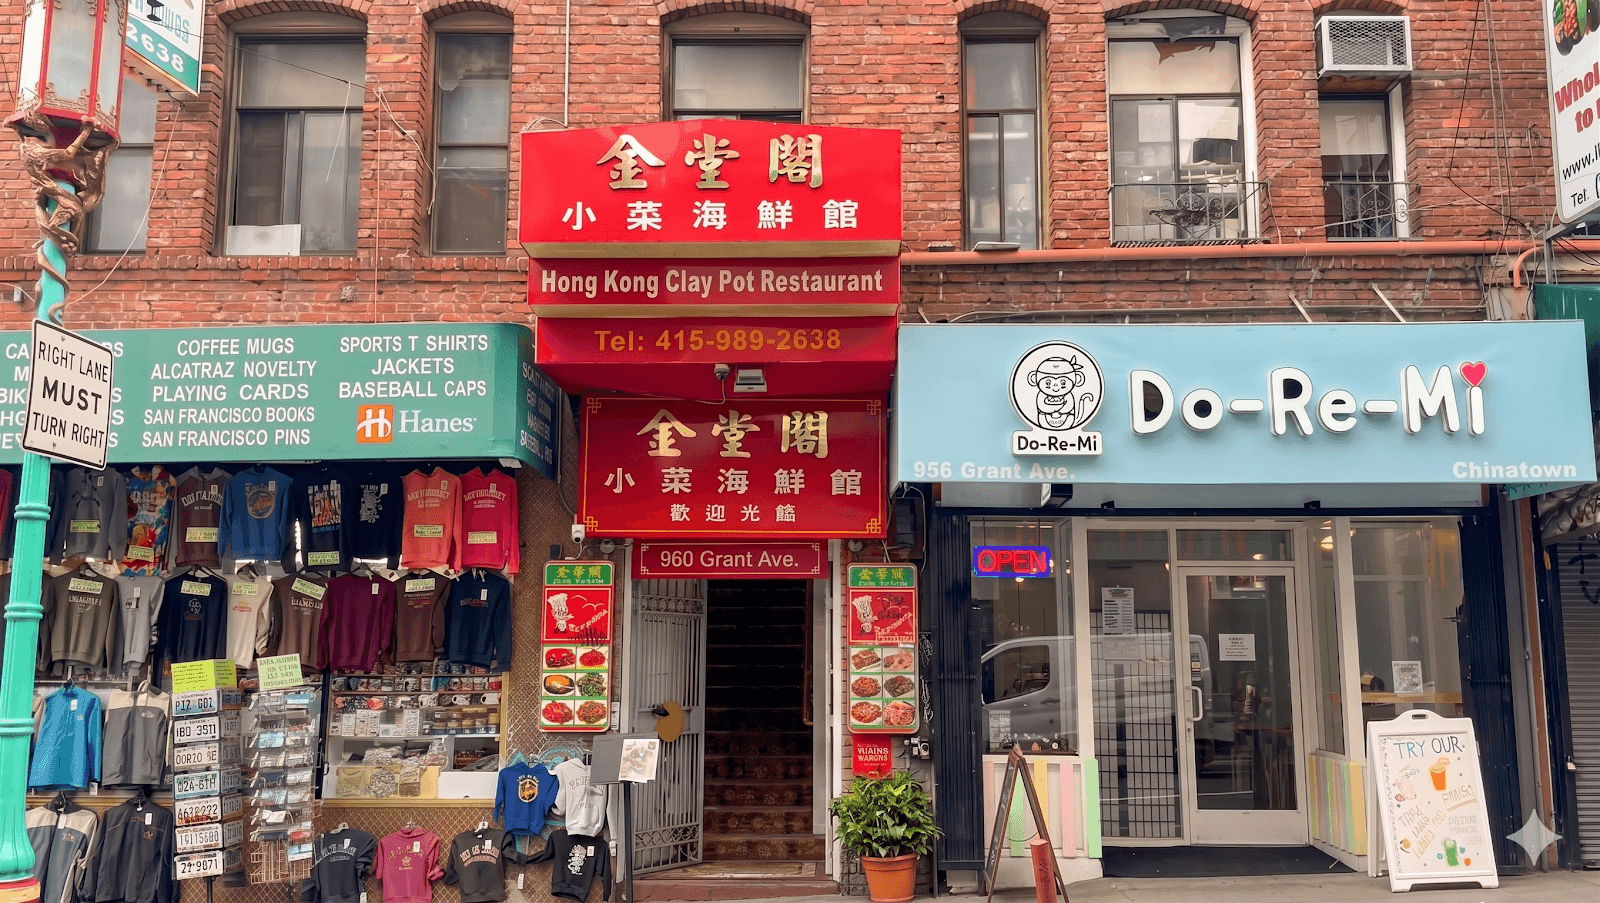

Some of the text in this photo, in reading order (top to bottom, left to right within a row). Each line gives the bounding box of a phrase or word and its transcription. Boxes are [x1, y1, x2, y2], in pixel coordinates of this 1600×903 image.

[1554, 61, 1600, 114] Whol
[1574, 107, 1594, 134] to
[562, 199, 858, 231] 小菜海鮮館
[542, 270, 882, 298] Hong Kong Clay Pot Restaurant
[178, 338, 294, 356] COFFEE MUGS
[340, 335, 487, 352] SPORTS T SHIRTS
[595, 330, 840, 351] Tel: 415-989-2638
[37, 338, 110, 385] RIGHT LANE
[151, 361, 317, 379] ALCATRAZ NOVELTY
[372, 358, 454, 374] JACKETS
[42, 375, 102, 415] MUST
[153, 384, 308, 402] PLAYING CARDS
[340, 381, 486, 398] BASEBALL CAPS
[1130, 361, 1489, 438] Do-Re-Mi
[144, 407, 314, 424] SAN FRANCISCO BOOKS
[396, 408, 478, 434] Hanes
[32, 411, 105, 449] TURN RIGHT
[142, 429, 310, 447] SAN FRANCISCO PINS
[1017, 434, 1097, 452] Do-Re-Mi
[912, 460, 1076, 481] 956 Grant Ave.
[1452, 461, 1577, 479] Chinatown
[605, 468, 861, 495] 小菜海鮮館
[661, 551, 798, 566] 960 Grant Ave.
[977, 549, 1048, 573] OPEN
[1393, 736, 1462, 760] TRY OUR
